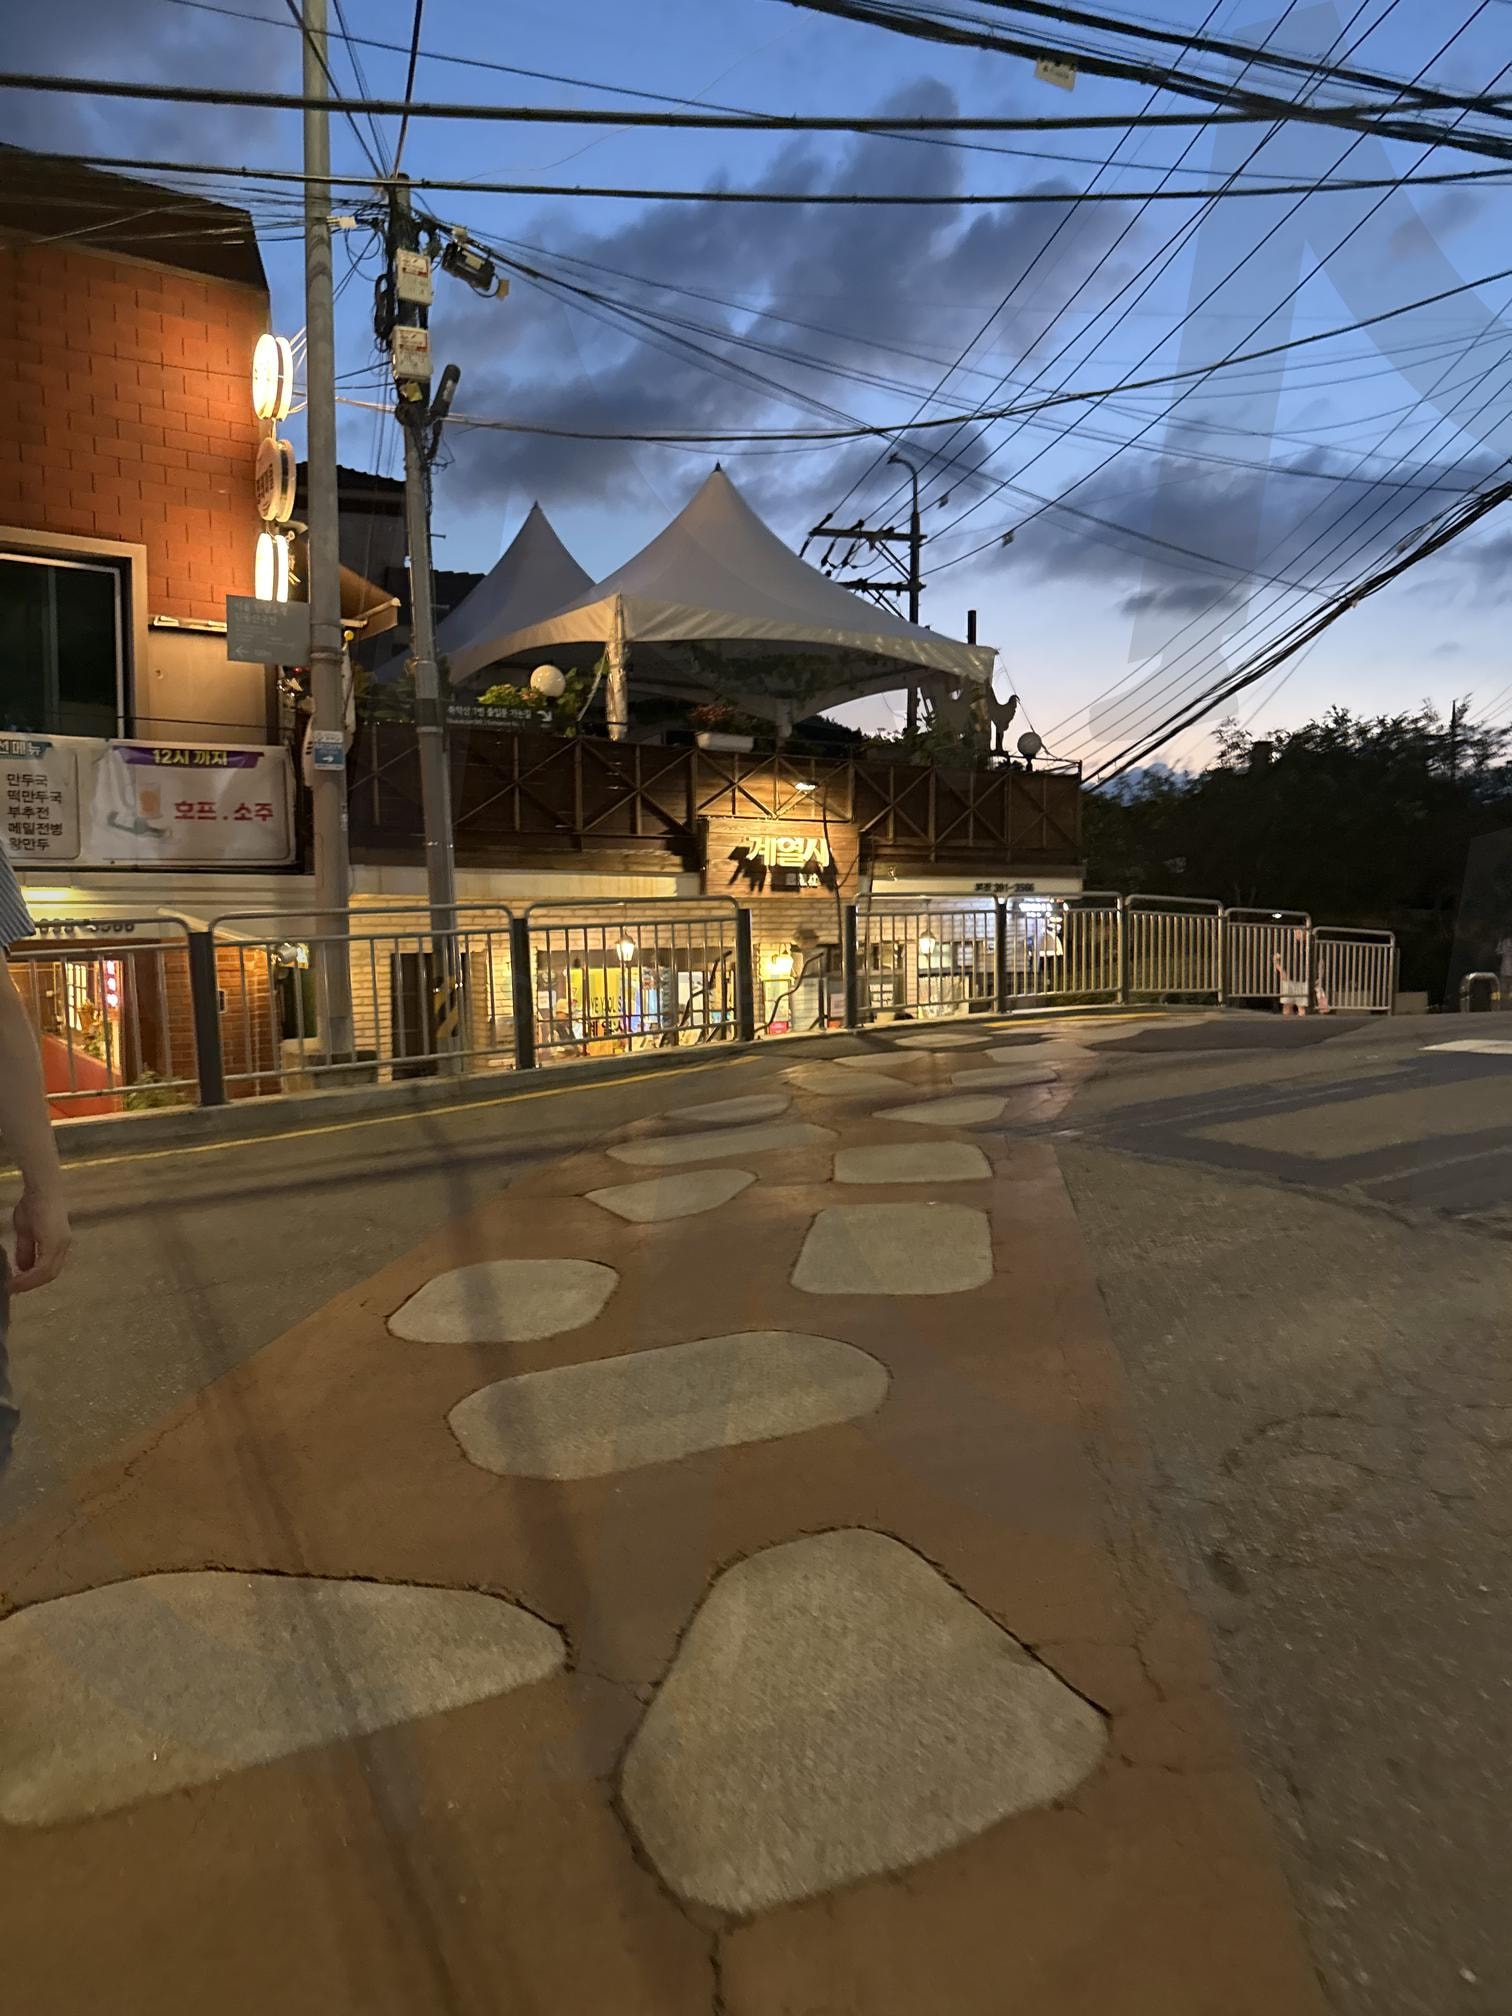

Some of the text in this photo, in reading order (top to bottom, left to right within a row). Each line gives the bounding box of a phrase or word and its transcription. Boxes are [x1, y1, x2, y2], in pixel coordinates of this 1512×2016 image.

[152, 749, 228, 766] 12시 까지
[7, 773, 48, 787] 만두국
[7, 789, 62, 804] 떡만두국
[7, 806, 50, 820] 부추전
[8, 822, 63, 836] 메밀전병
[8, 837, 50, 851] 왕만두
[746, 836, 830, 868] 계열사
